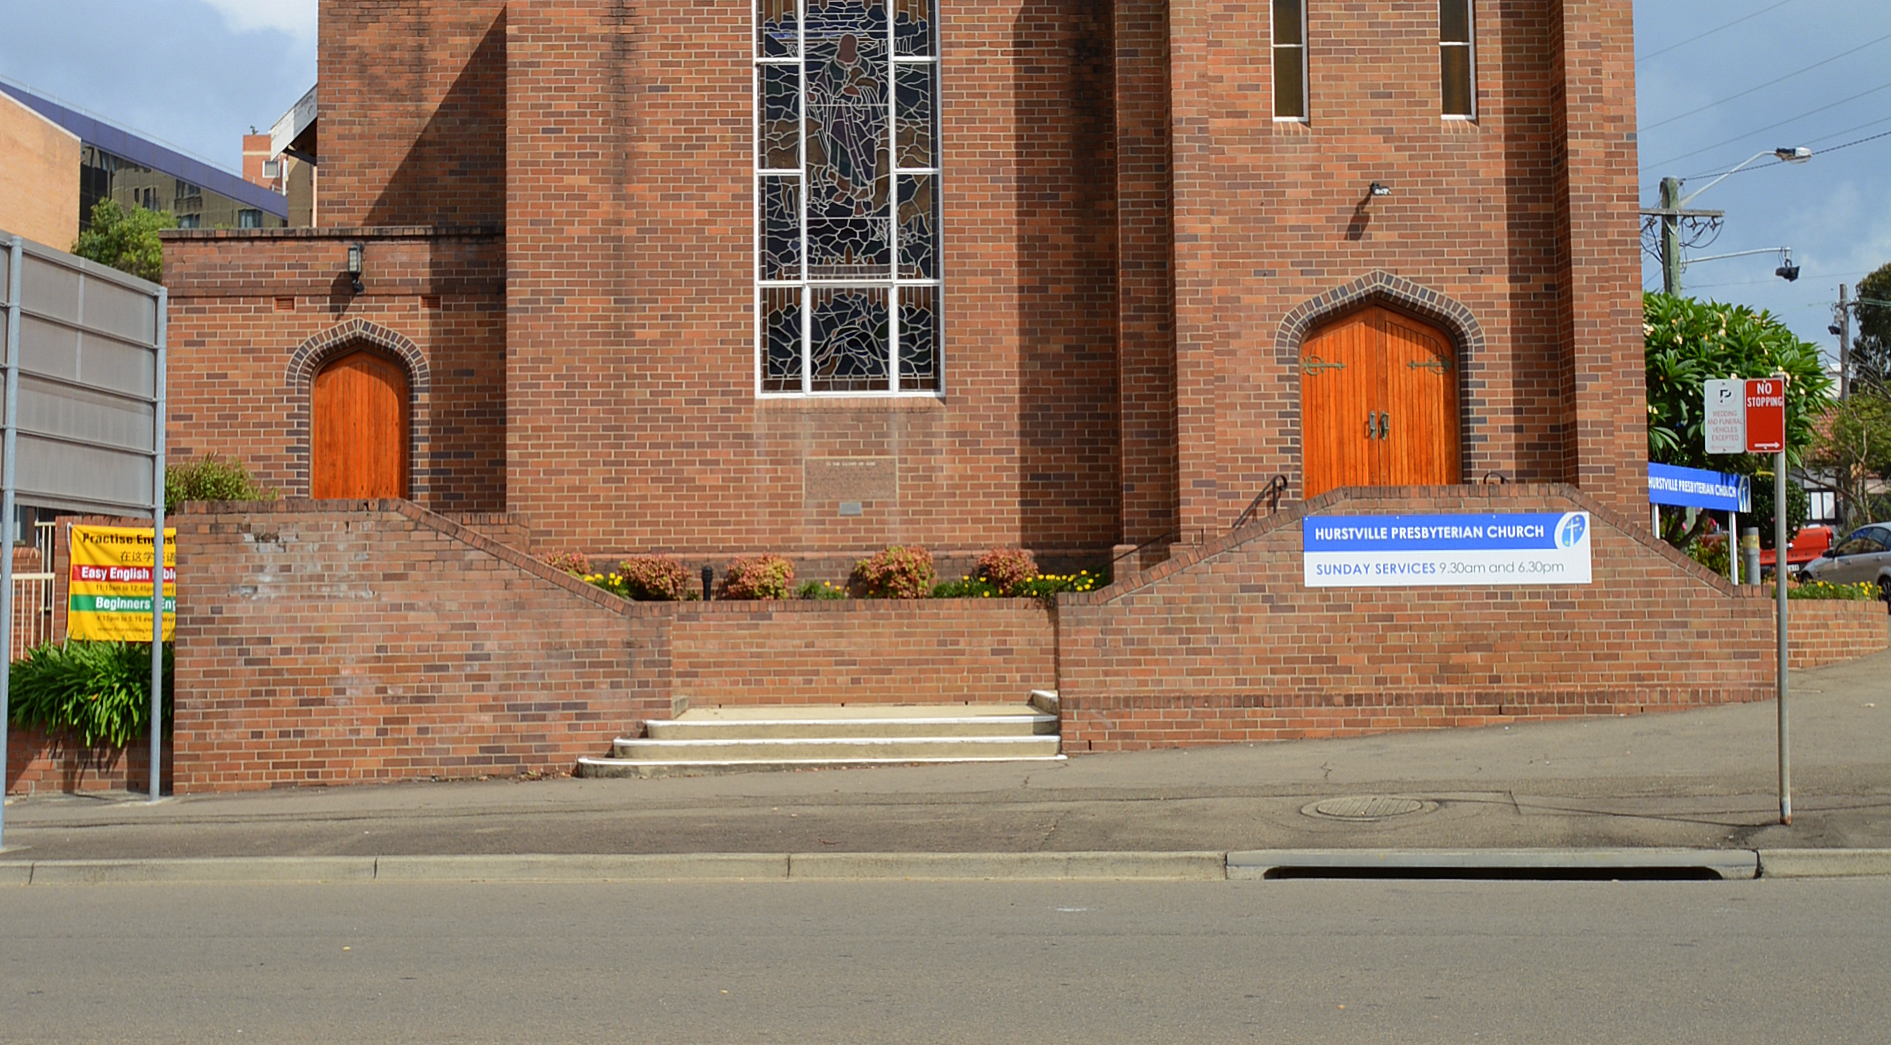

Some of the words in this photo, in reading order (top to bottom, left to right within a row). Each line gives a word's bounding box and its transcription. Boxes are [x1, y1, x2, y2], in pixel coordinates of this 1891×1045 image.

[1756, 382, 1773, 395] NO
[1747, 396, 1783, 408] STOPPING
[1712, 426, 1738, 434] VEHICLES
[1648, 476, 1678, 492] HURSTVILLE
[1679, 480, 1715, 496] PRESBYTERIAN
[1715, 484, 1737, 498] CHURCH
[83, 533, 133, 544] Practise
[1315, 527, 1388, 541] HURSTVILLE
[1391, 526, 1483, 540] PRESBYTERIAN
[1487, 525, 1544, 538] CHURCH
[120, 551, 176, 563] 在这学语
[81, 566, 107, 581] Easy
[110, 567, 149, 581] English
[1316, 563, 1371, 576] SUNDAY
[1375, 562, 1436, 575] SERVICES
[1440, 561, 1486, 574] 9.30am
[1488, 561, 1515, 574] and
[1517, 560, 1565, 575] 6.30pm
[95, 596, 154, 610] Beginners'
